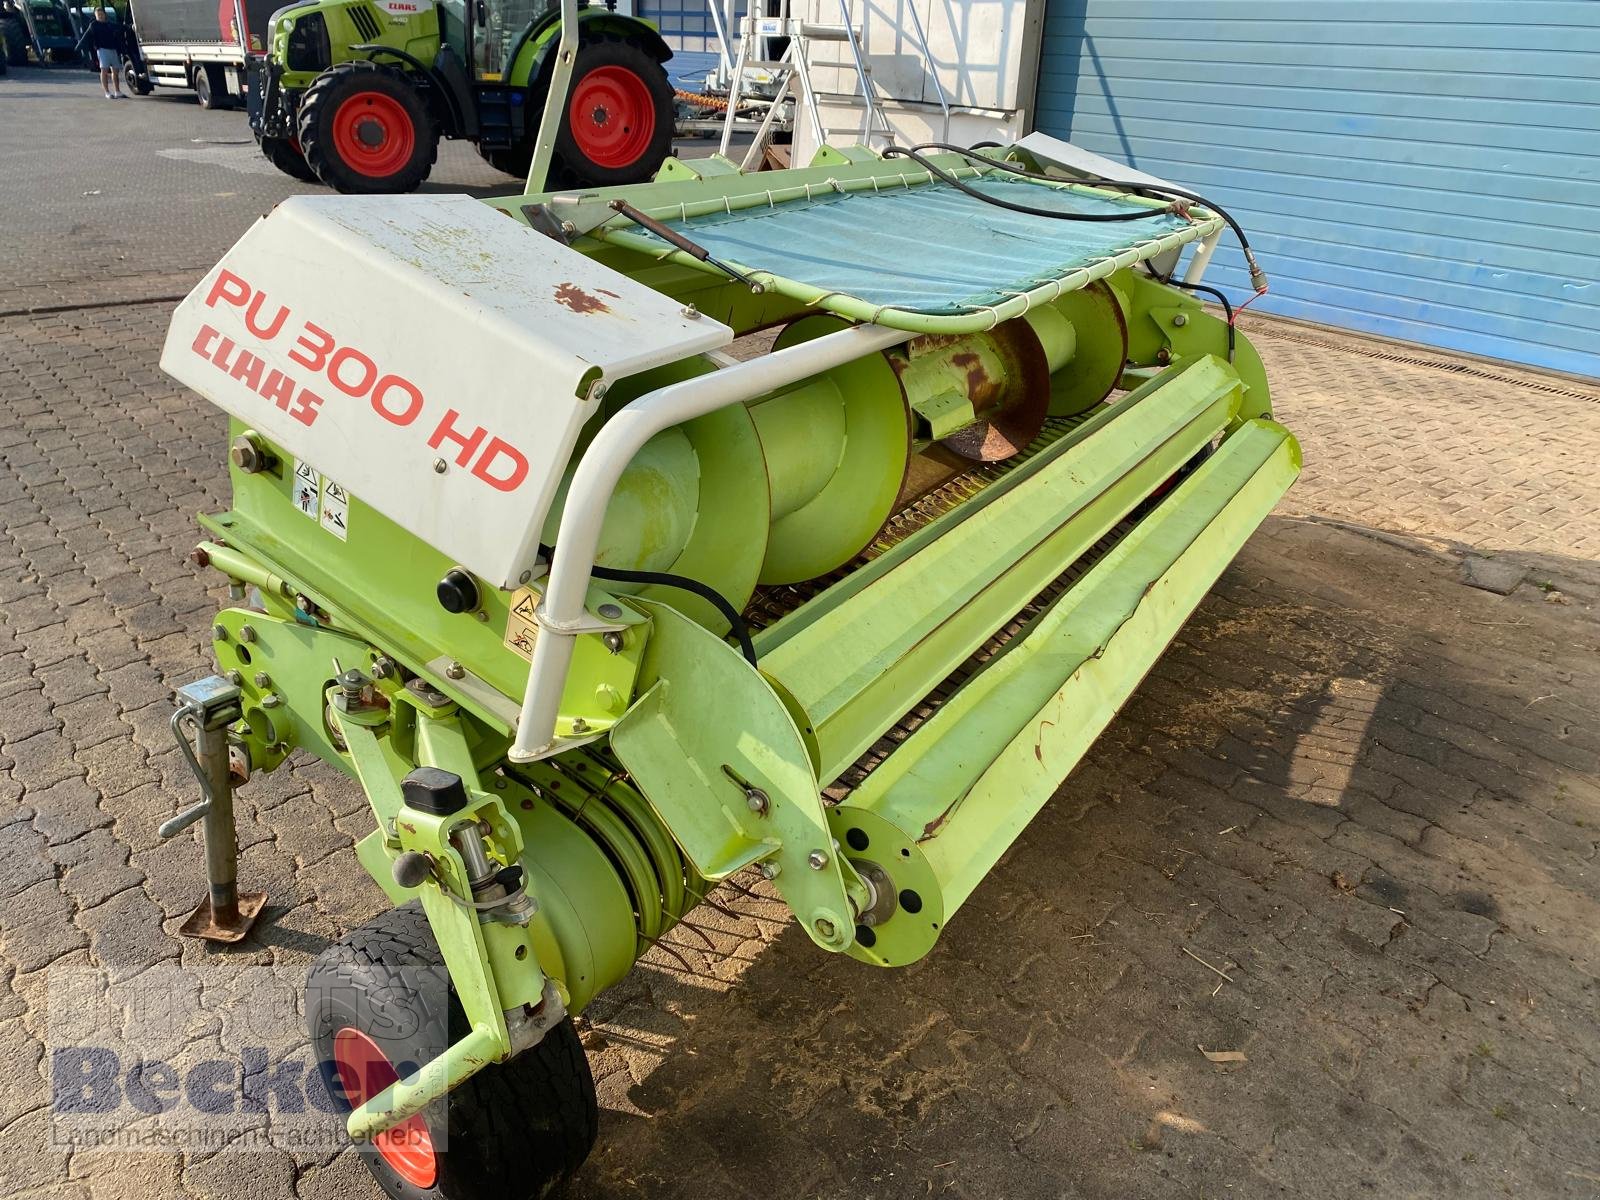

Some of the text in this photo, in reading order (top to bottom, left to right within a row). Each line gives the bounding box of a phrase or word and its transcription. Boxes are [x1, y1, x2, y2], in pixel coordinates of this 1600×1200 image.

[388, 2, 417, 11] CLAAS
[192, 324, 324, 427] CLAAS
[205, 269, 529, 492] PU 300 HD
